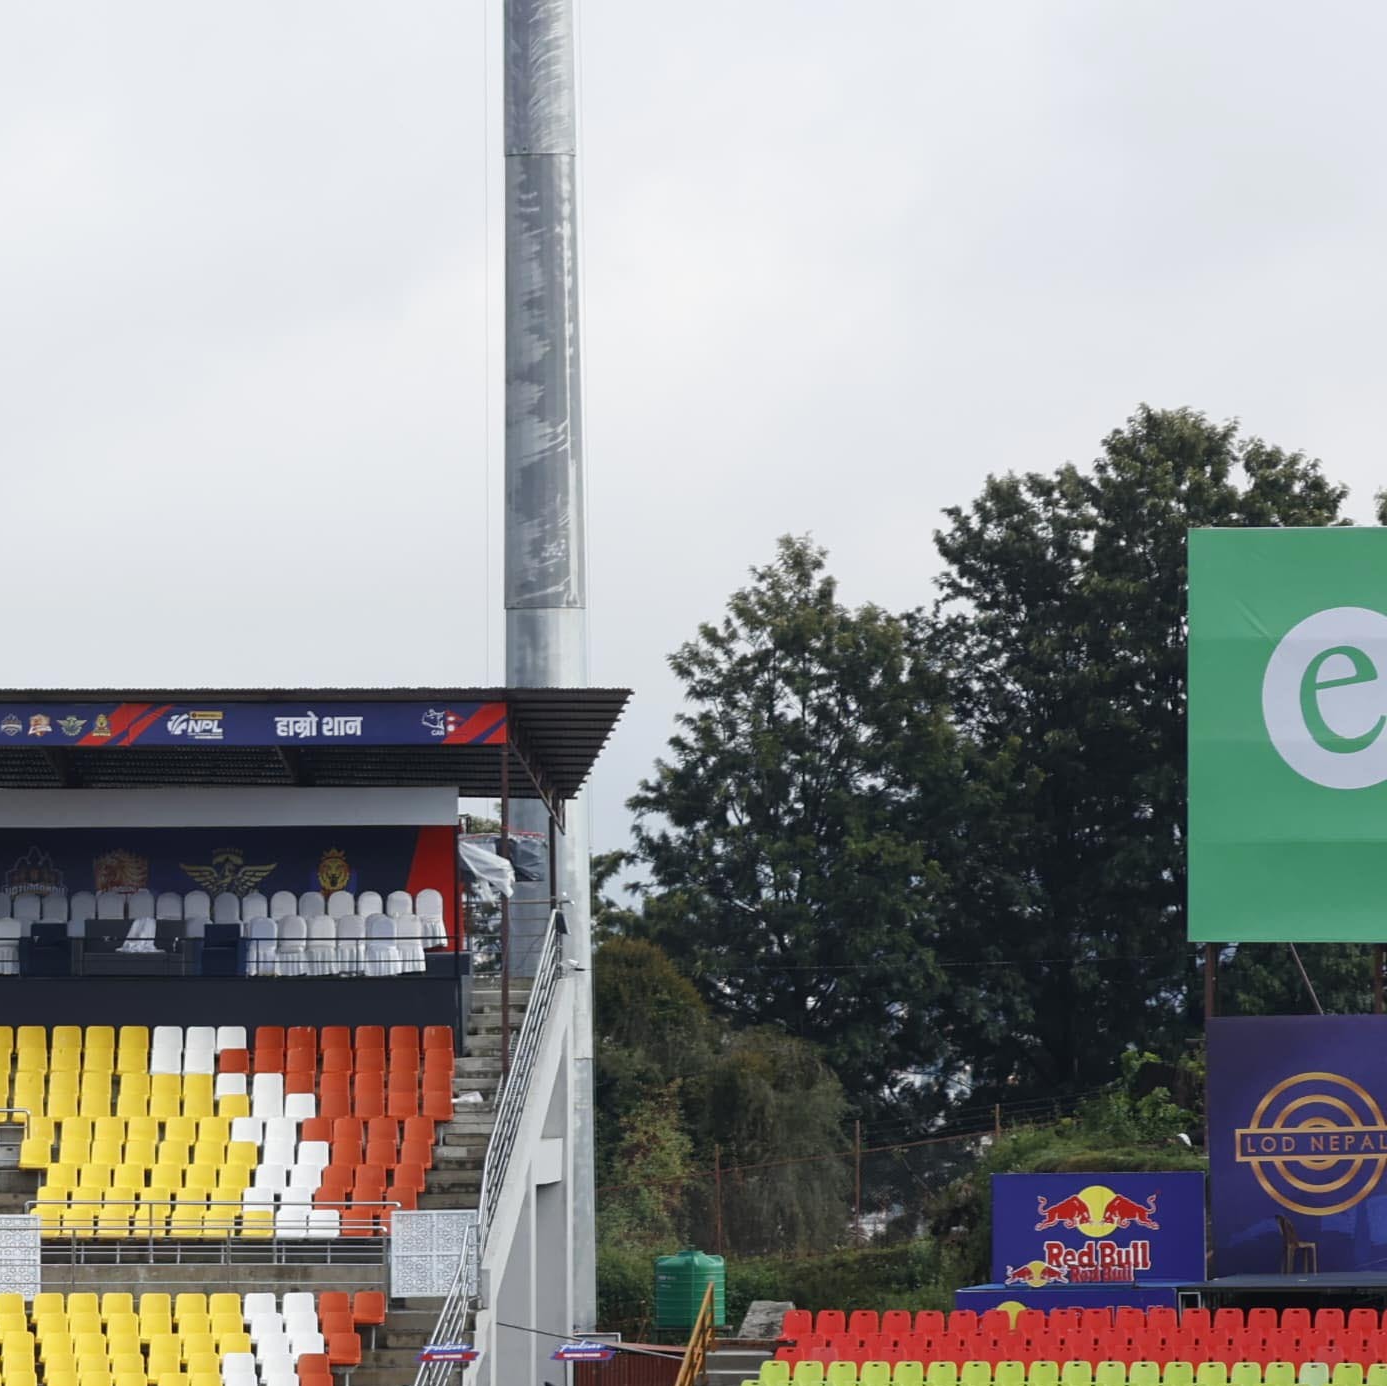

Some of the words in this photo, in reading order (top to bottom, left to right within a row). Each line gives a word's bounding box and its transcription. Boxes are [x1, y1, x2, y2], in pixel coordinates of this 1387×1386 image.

[1299, 645, 1387, 754] e
[188, 720, 223, 737] NPL
[275, 711, 318, 739] हाम्रो
[322, 714, 362, 737] शान
[1246, 1135, 1296, 1153] LOD
[1310, 1134, 1387, 1152] NEPAL
[1044, 1241, 1096, 1268] Red
[1098, 1241, 1151, 1269] Bull
